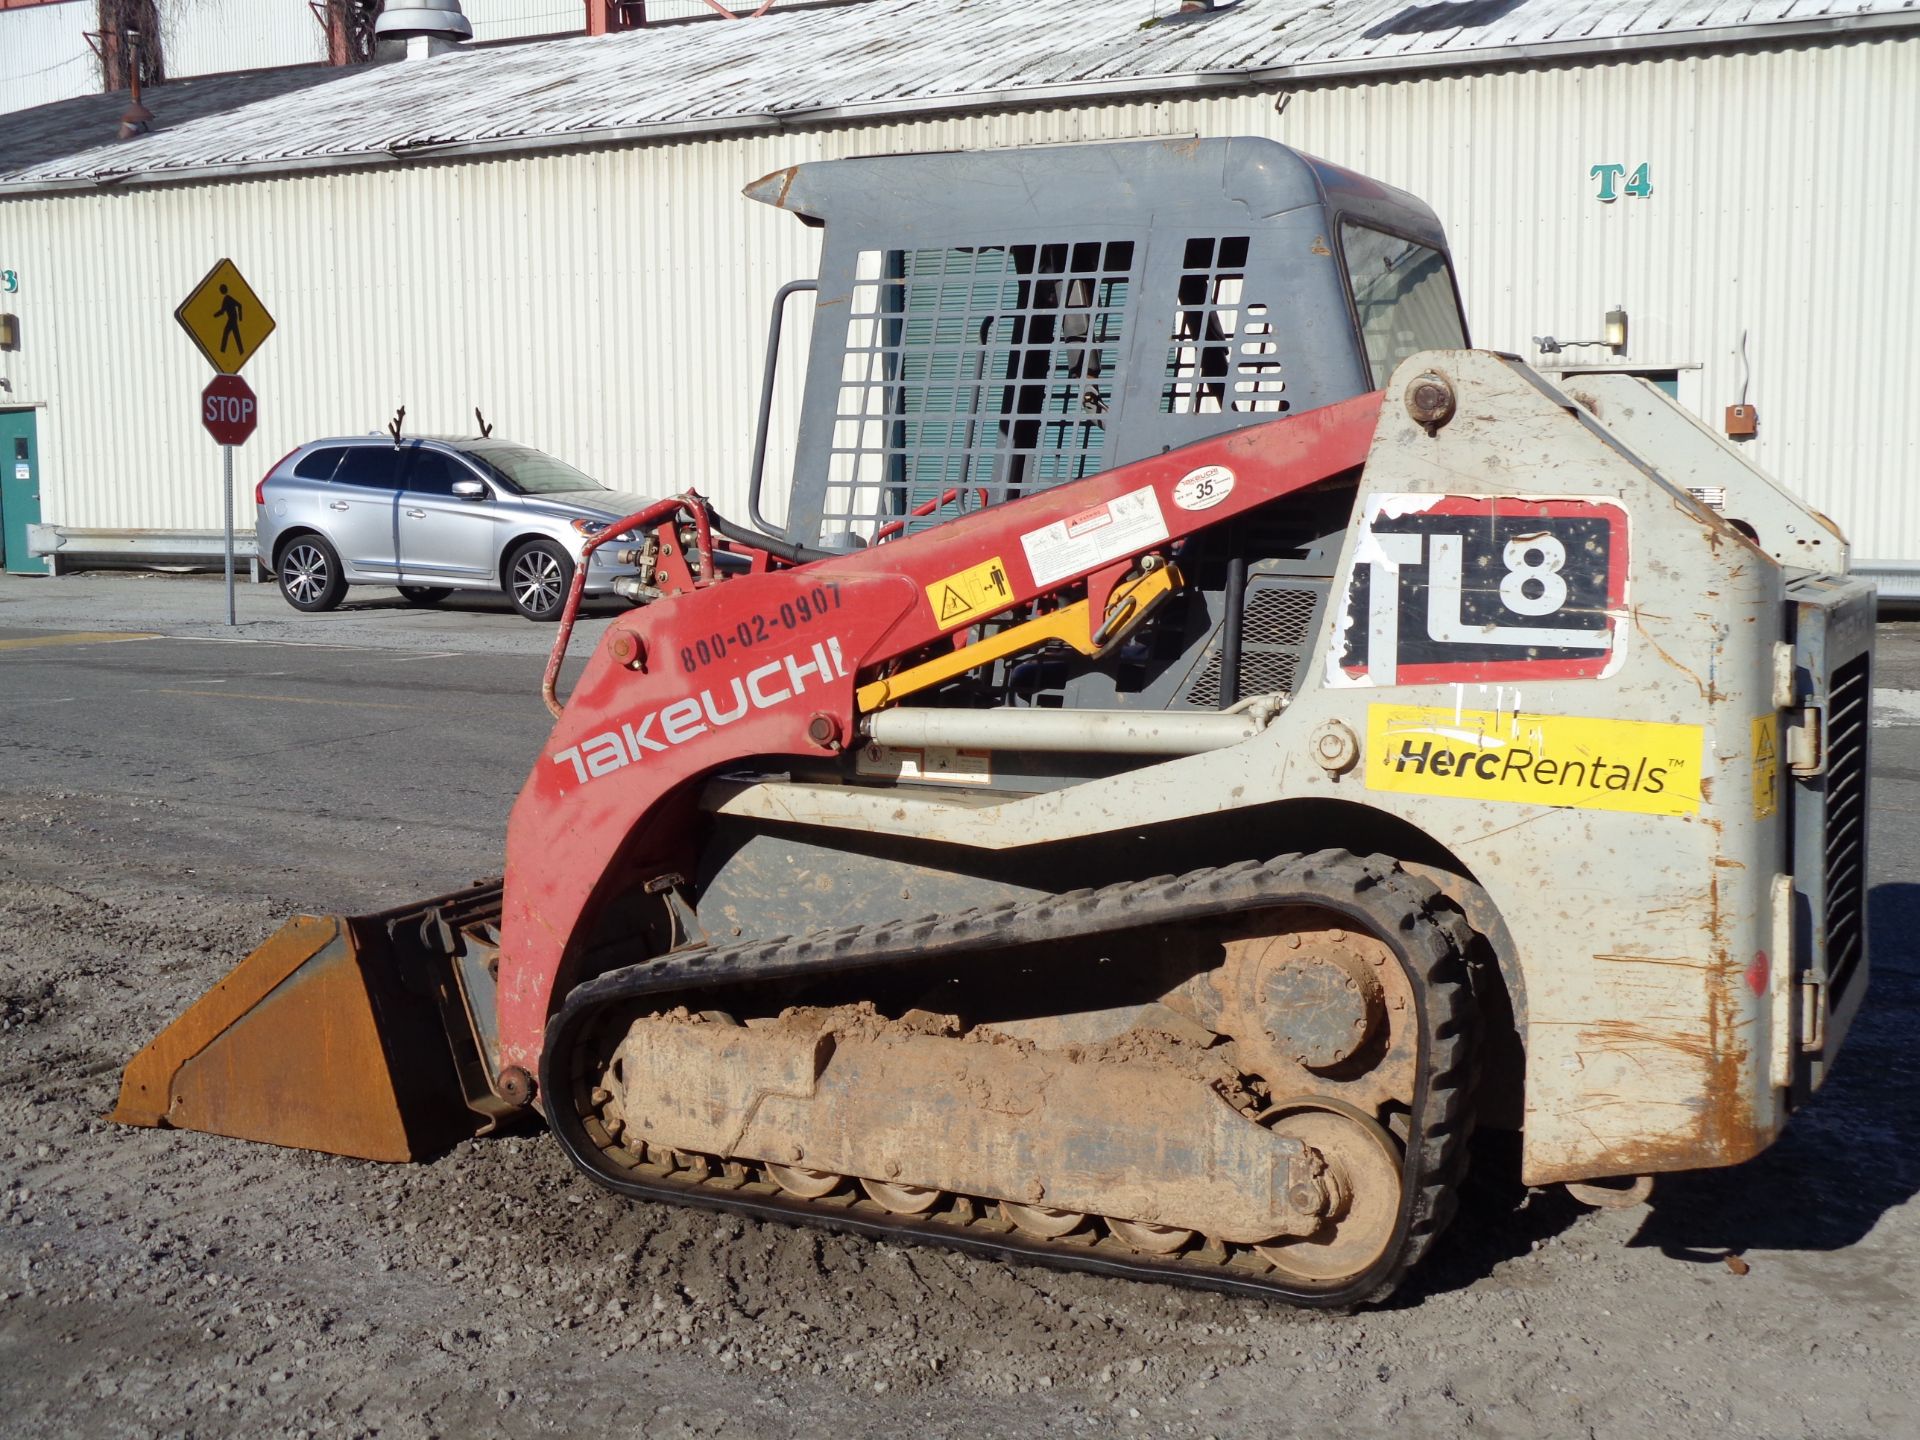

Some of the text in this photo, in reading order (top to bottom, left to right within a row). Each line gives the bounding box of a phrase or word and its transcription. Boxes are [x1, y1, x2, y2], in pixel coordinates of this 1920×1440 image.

[1590, 162, 1652, 201] T4
[0, 269, 17, 292] 3
[206, 395, 254, 423] STOP
[1196, 479, 1213, 499] 35
[681, 582, 842, 673] 800-02-0907
[1356, 531, 1613, 686] TL8
[554, 636, 849, 784] TAKEUCHI
